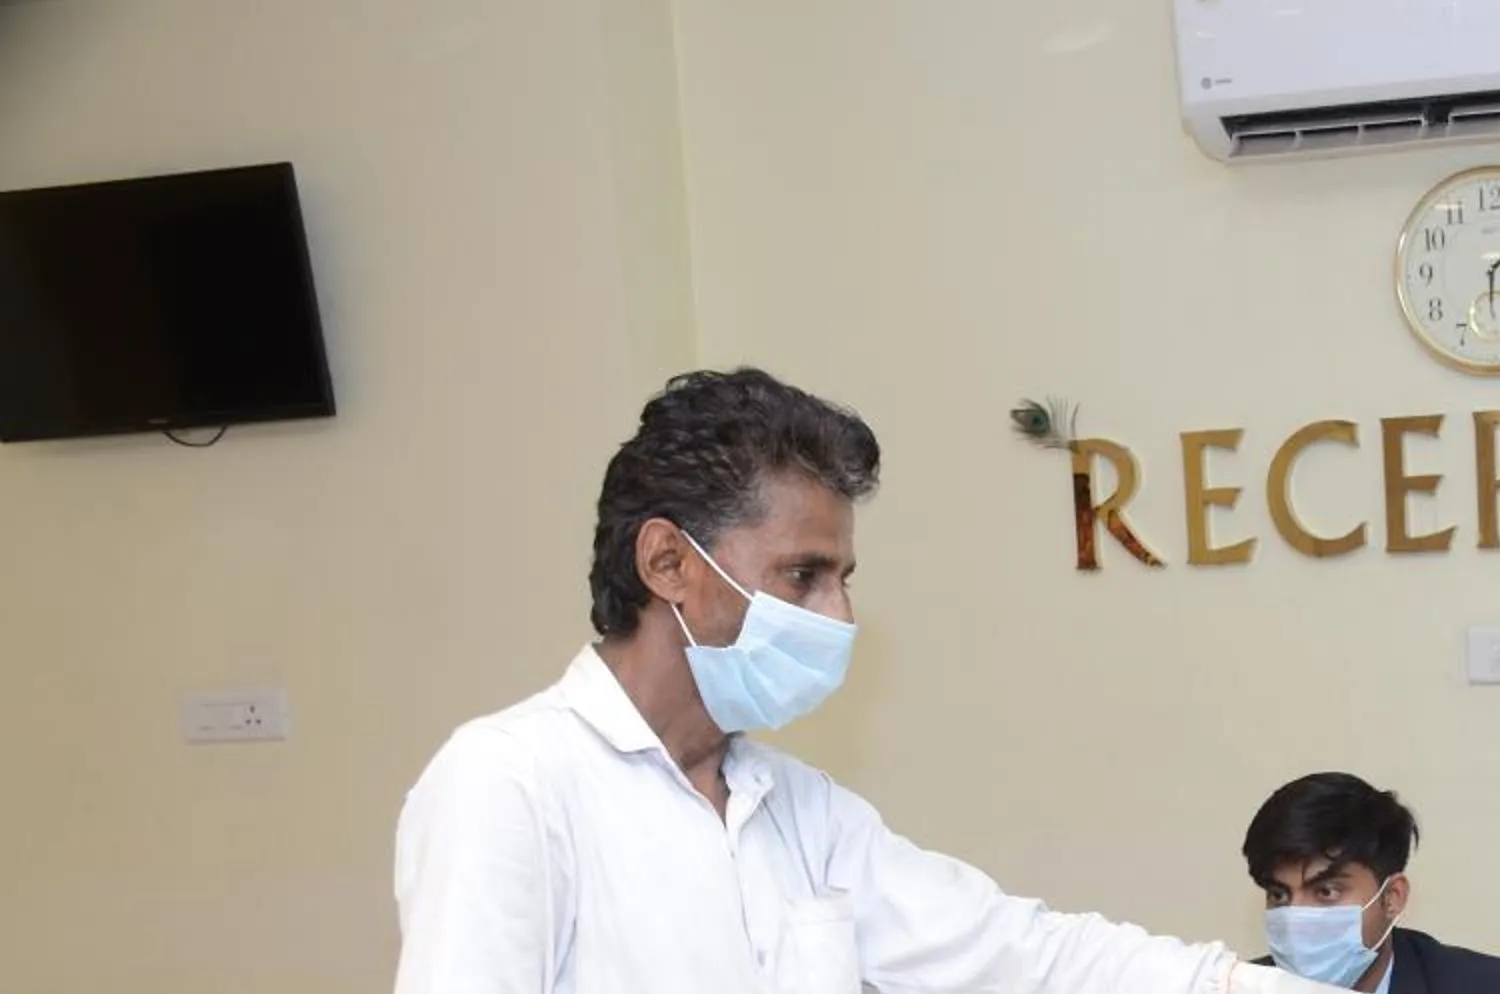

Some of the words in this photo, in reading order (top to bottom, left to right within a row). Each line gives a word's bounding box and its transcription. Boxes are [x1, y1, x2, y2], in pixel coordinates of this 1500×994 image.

[1446, 200, 1464, 225] 11
[1424, 227, 1446, 251] 10
[1418, 262, 1434, 287] 9
[1428, 299, 1444, 322] 8
[1455, 322, 1468, 347] 7
